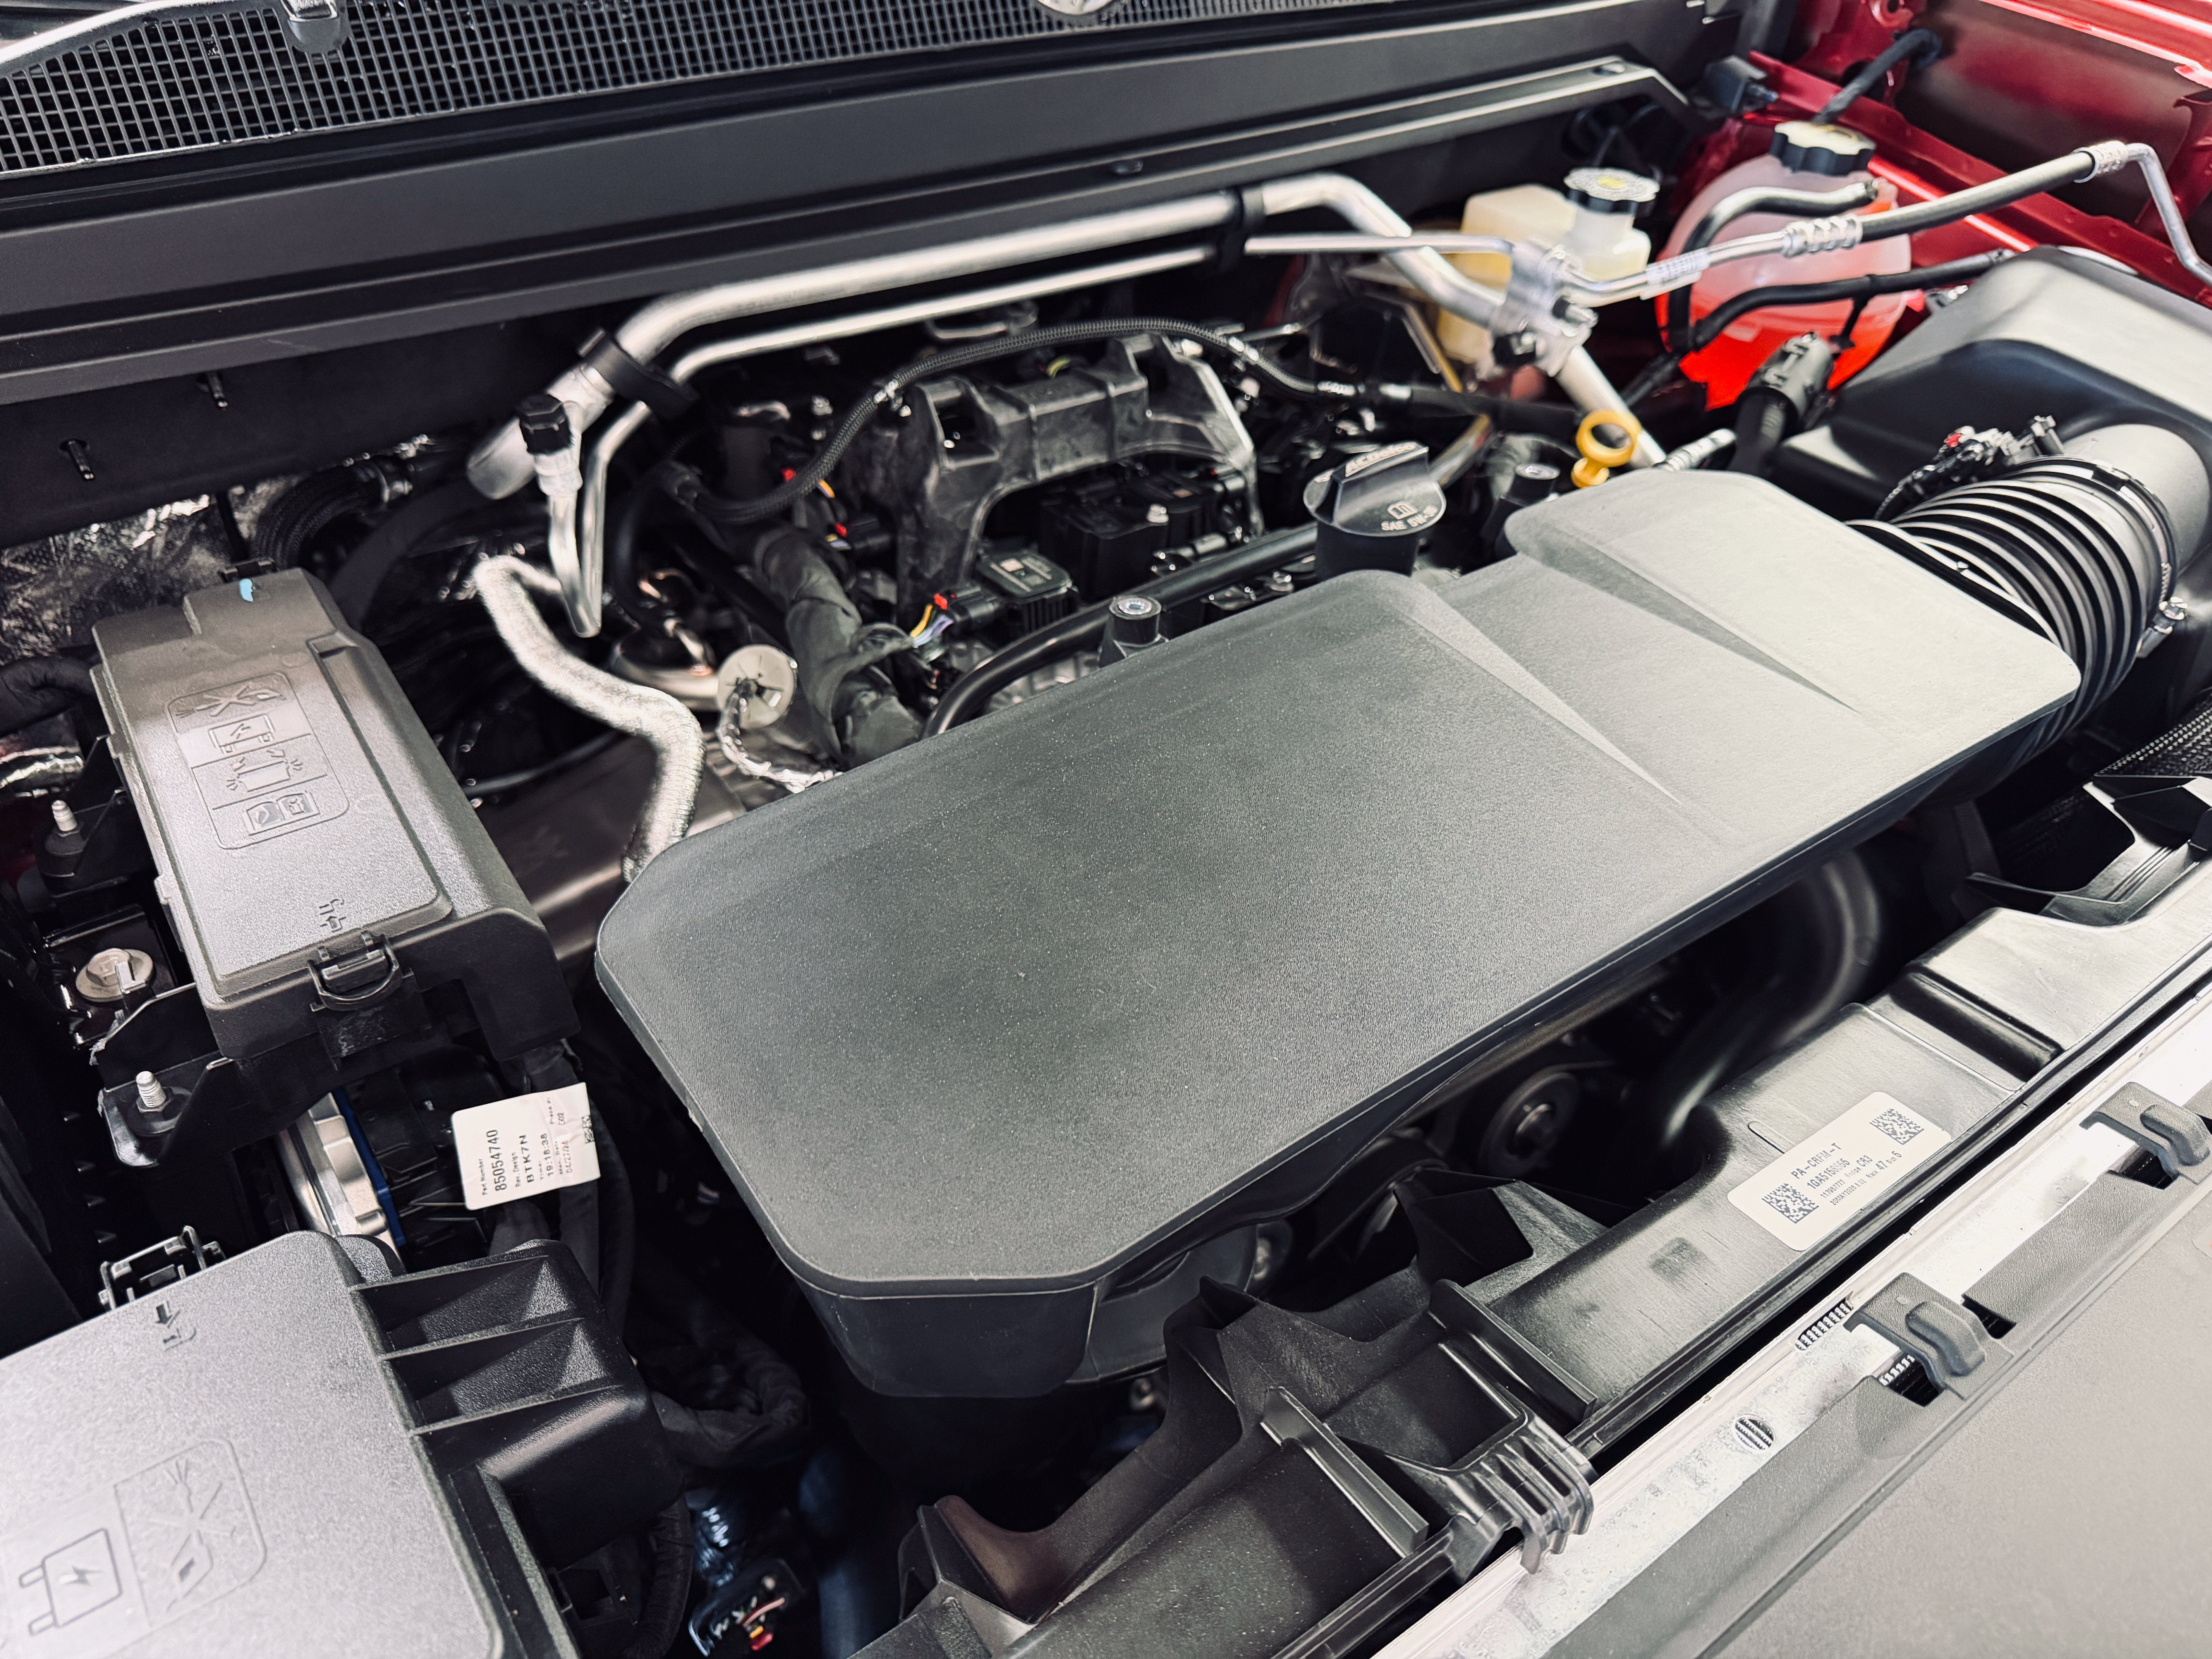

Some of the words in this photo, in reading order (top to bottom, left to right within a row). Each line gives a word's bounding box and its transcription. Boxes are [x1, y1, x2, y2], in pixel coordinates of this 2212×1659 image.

[1381, 520, 1407, 531] SAE
[486, 1130, 507, 1191] 85054740
[519, 1135, 534, 1183] BTK7N
[541, 1133, 554, 1176] 19:18:38
[1791, 1143, 1841, 1179] PA-CRFM-T
[1856, 1155, 1873, 1166] CR3
[1875, 1161, 1887, 1170] 47
